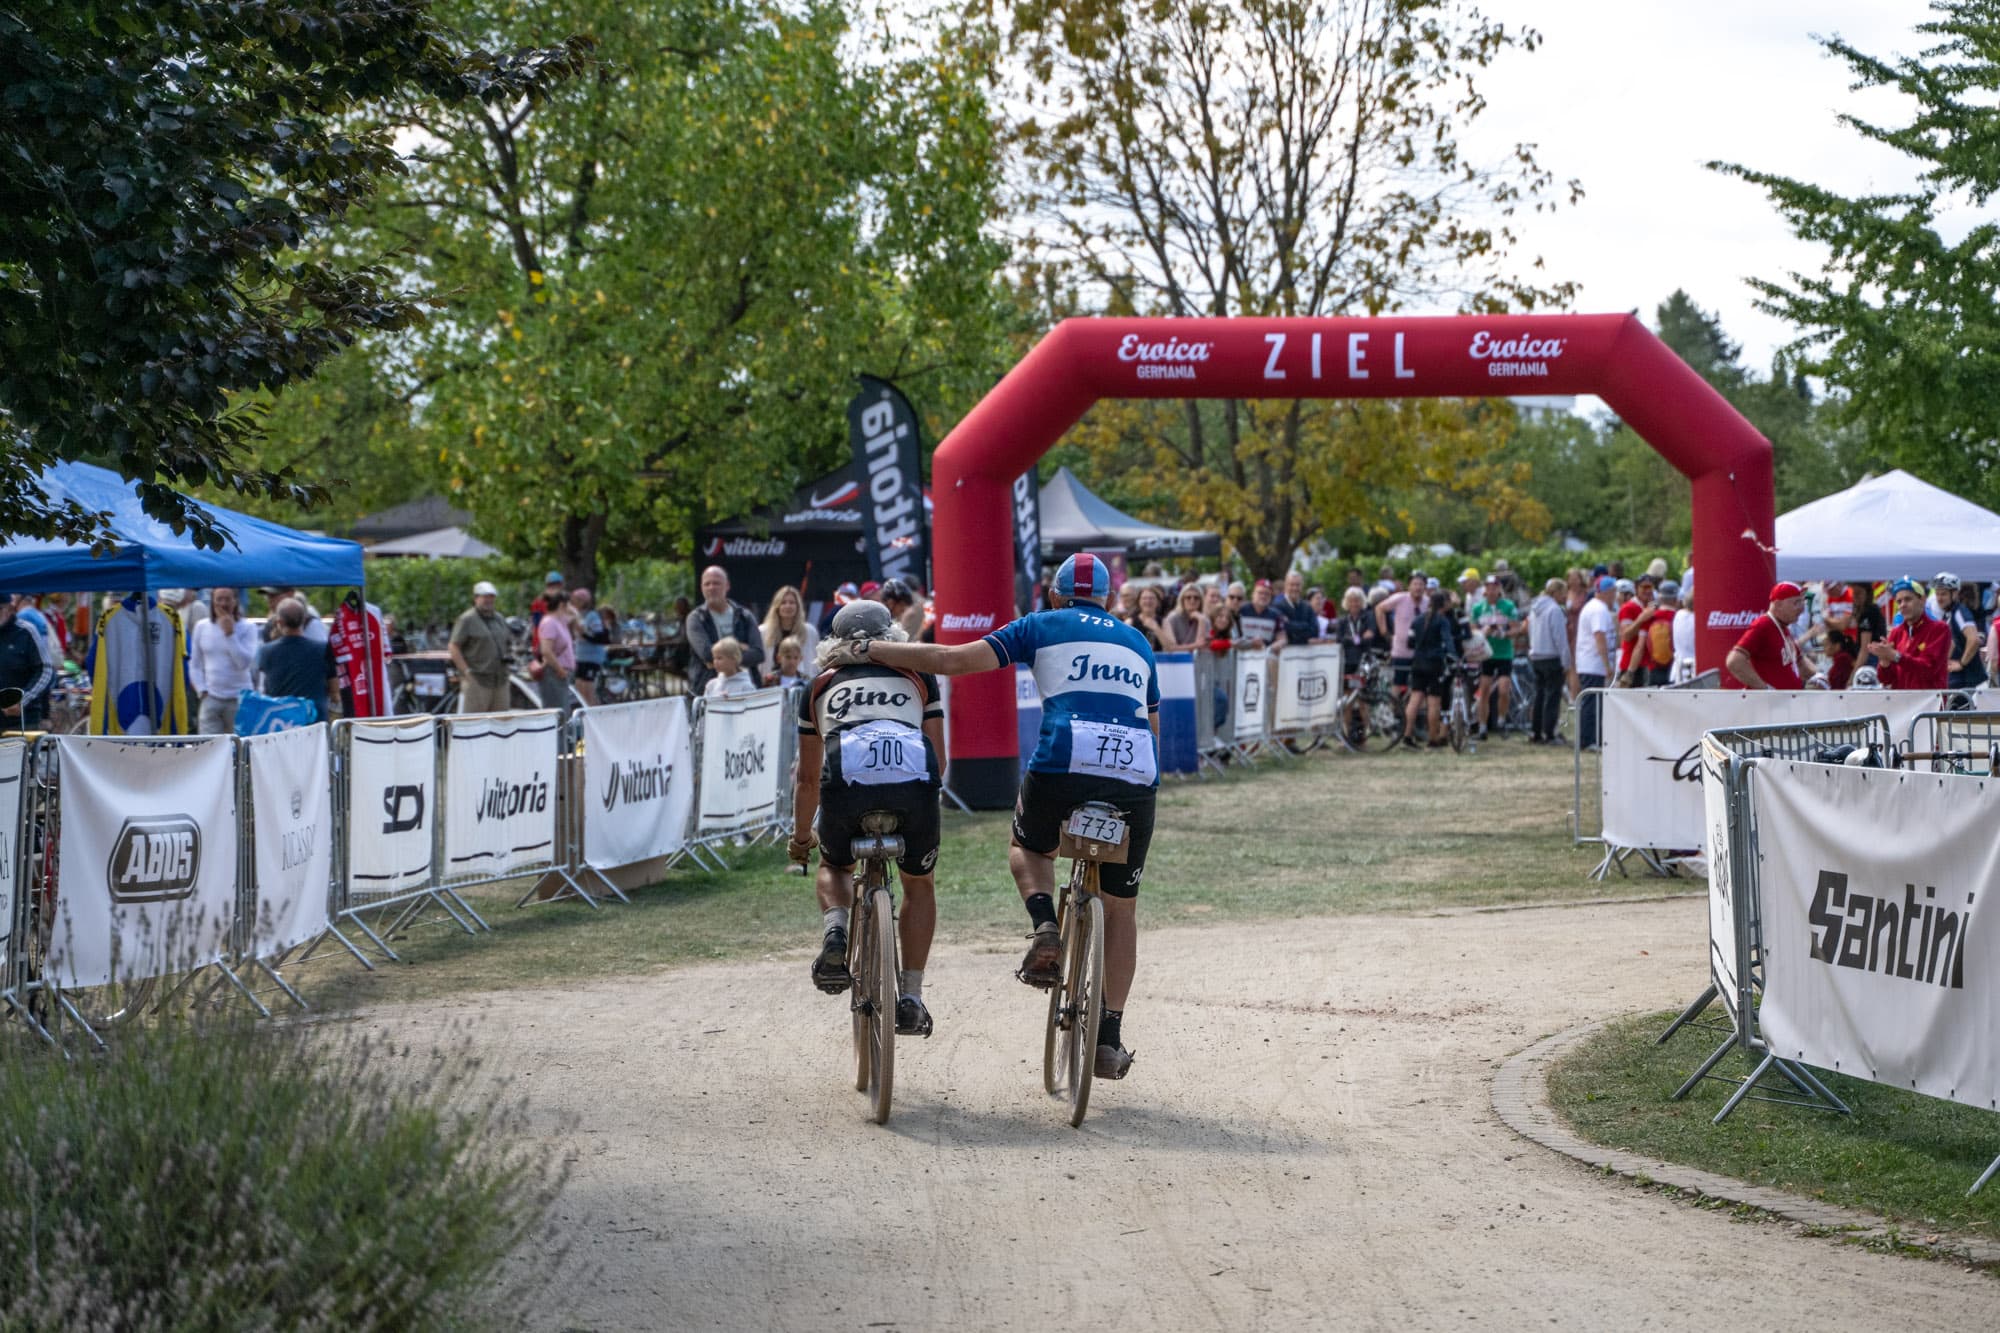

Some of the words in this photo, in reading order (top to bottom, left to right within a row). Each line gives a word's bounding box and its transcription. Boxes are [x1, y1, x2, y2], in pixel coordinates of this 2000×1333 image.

[1117, 333, 1210, 362] Eroica
[1263, 332, 1415, 379] ZIEL
[1468, 331, 1564, 360] Eroica
[1136, 364, 1196, 379] GERMANIA
[1488, 361, 1548, 377] GERMANIA
[723, 537, 786, 556] vittoria
[941, 612, 995, 629] Santini
[1079, 613, 1115, 628] 773
[1067, 653, 1144, 689] Inno
[827, 686, 911, 719] Gino
[864, 739, 903, 769] 500
[1096, 735, 1134, 766] 773
[621, 753, 673, 805] vittoria
[487, 771, 547, 821] vittoria
[1081, 815, 1118, 840] 773
[120, 831, 193, 885] ABUS
[1808, 869, 1975, 989] Santini
